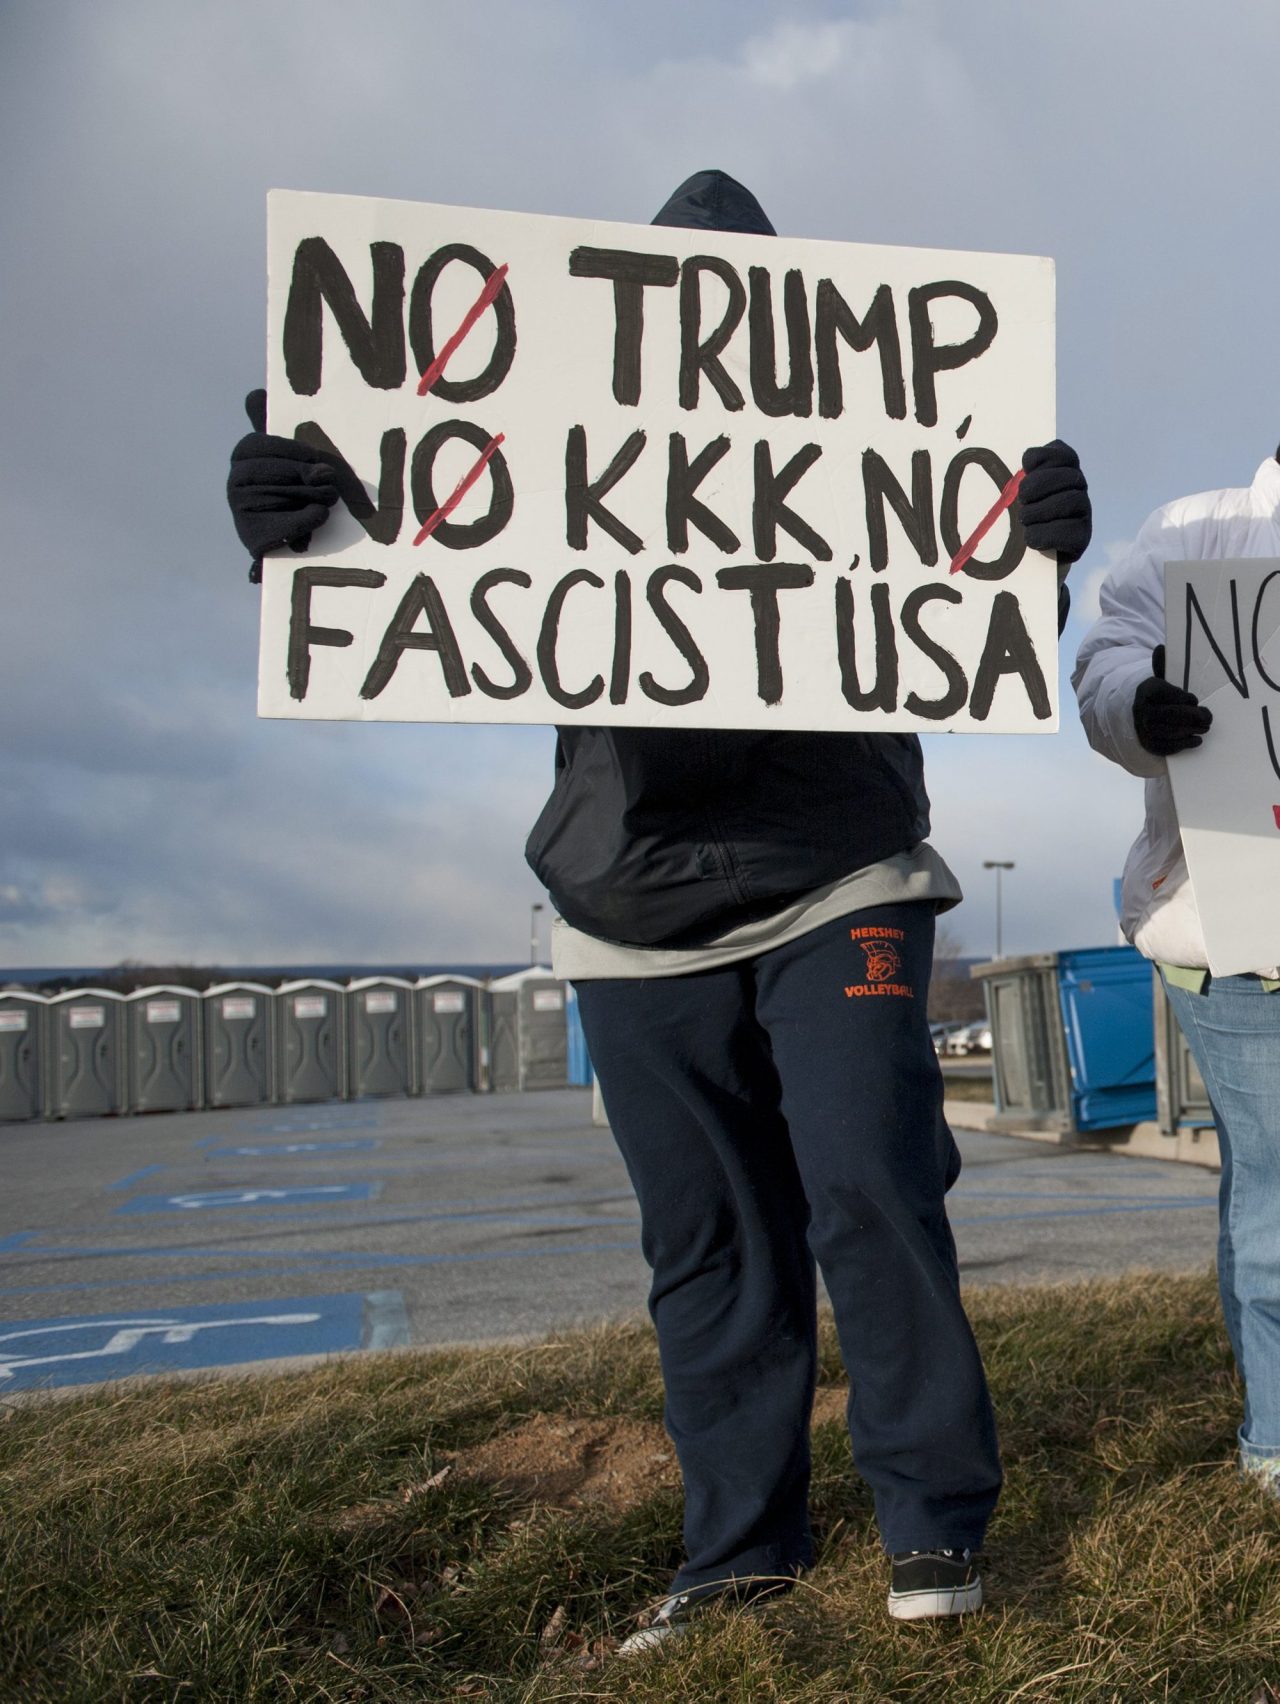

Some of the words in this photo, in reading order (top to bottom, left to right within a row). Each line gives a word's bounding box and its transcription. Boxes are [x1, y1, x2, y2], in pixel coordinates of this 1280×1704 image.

[282, 236, 516, 402] NO
[286, 563, 815, 705] FASCIST
[835, 576, 1052, 720] USA
[850, 926, 904, 940] HERSHEY
[844, 983, 914, 997] VOLLEYBALL
